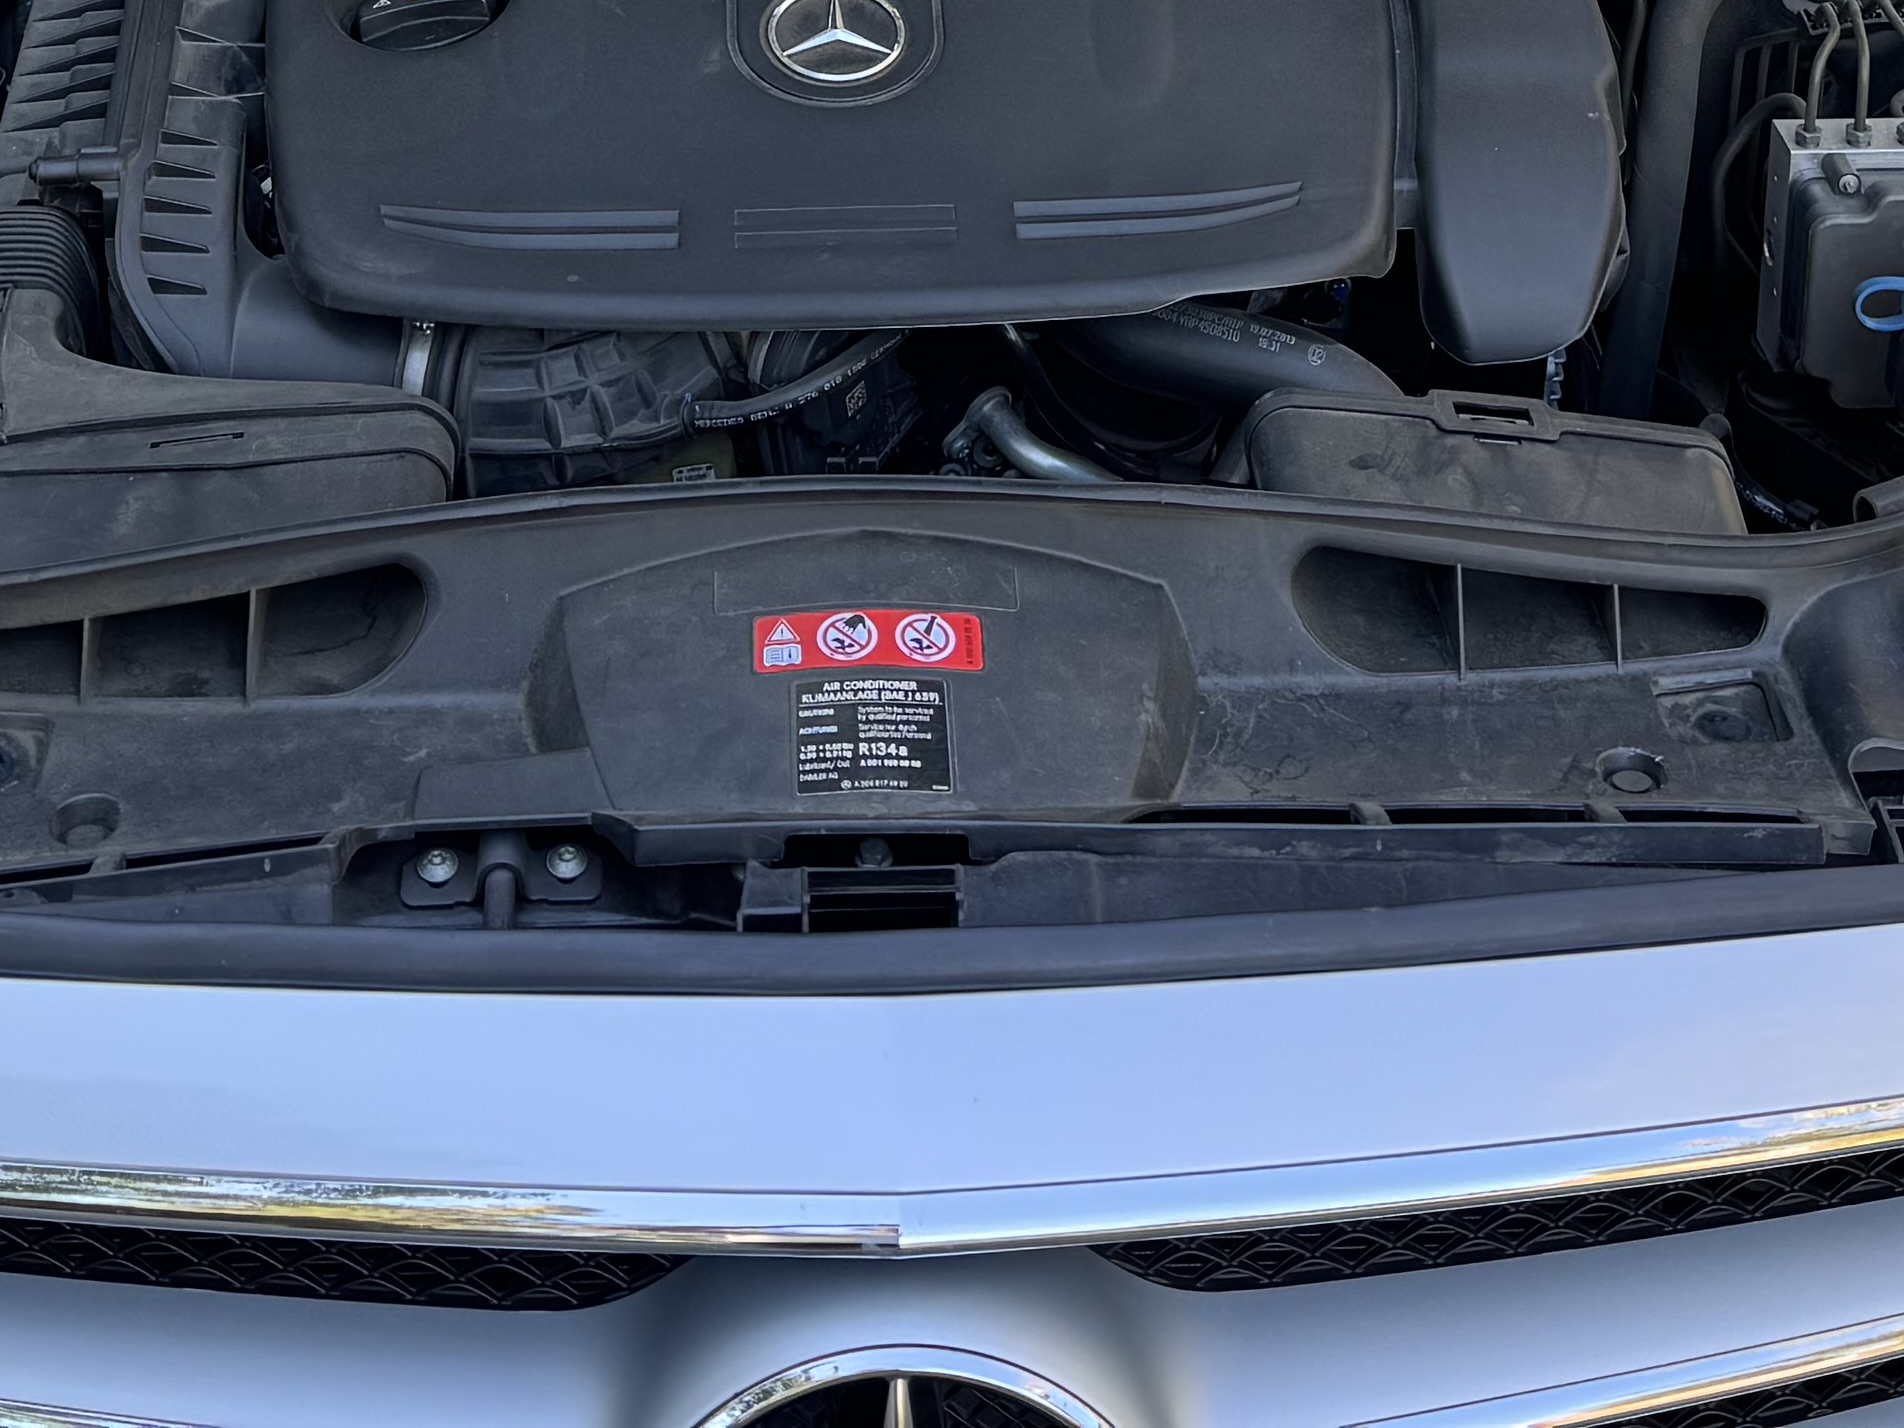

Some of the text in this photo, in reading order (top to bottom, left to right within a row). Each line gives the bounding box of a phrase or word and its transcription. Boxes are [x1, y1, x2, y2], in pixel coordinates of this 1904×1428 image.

[823, 680, 917, 692] AIR CONDITIONER
[801, 690, 879, 703] KLIMAANLAGE
[858, 742, 909, 757] R134a
